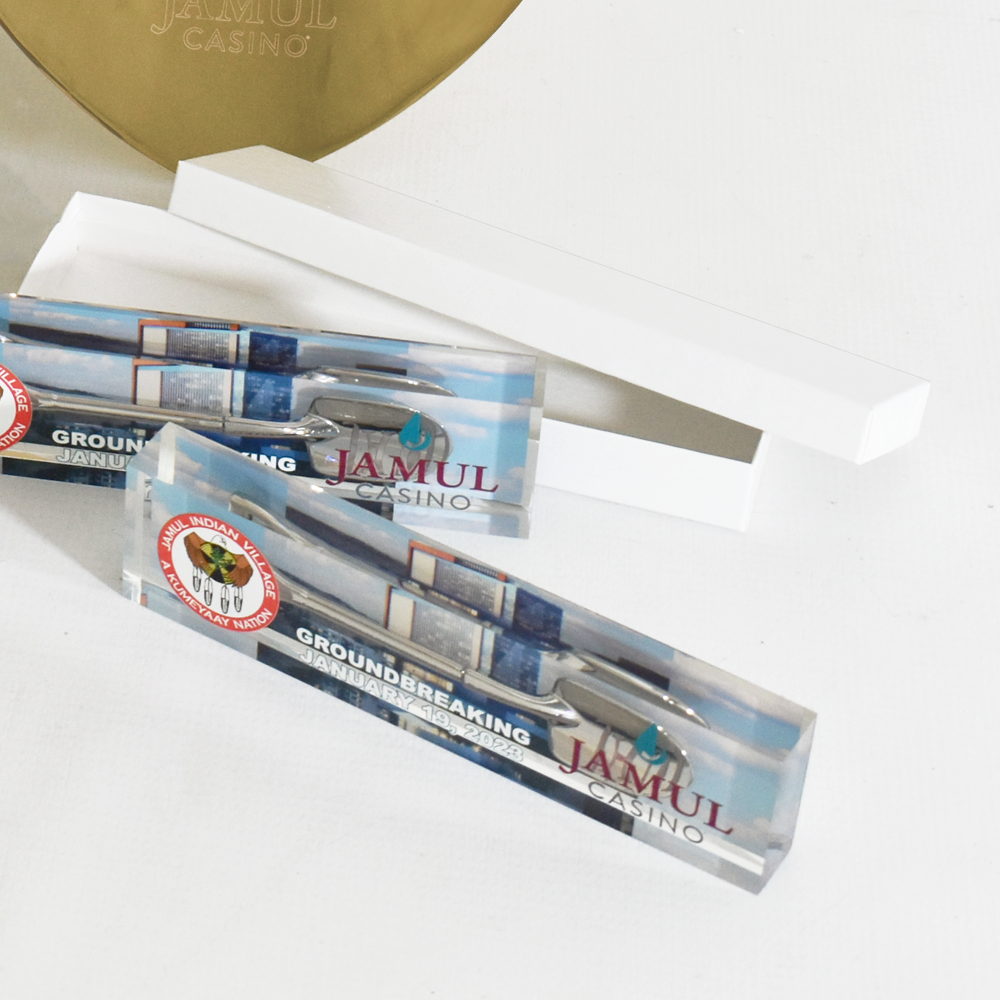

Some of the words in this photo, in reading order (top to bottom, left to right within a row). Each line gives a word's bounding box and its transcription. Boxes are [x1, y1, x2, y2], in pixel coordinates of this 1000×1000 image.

[183, 27, 308, 58] CASINO
[325, 448, 499, 493] JAMUL
[355, 482, 471, 511] CASINO
[161, 519, 189, 551] JAMUL
[189, 516, 239, 541] INDIAN
[243, 540, 276, 600] VILLAGE
[160, 560, 170, 569] A
[167, 573, 230, 627] KUMEYAAY
[233, 608, 273, 630] NATION
[296, 627, 531, 746] GROUNDBREAKING
[300, 649, 414, 711] JANUARY
[421, 704, 457, 736] 19,
[464, 724, 524, 763] 2023
[559, 736, 734, 835] JAMUL
[588, 781, 704, 844] CASINO
